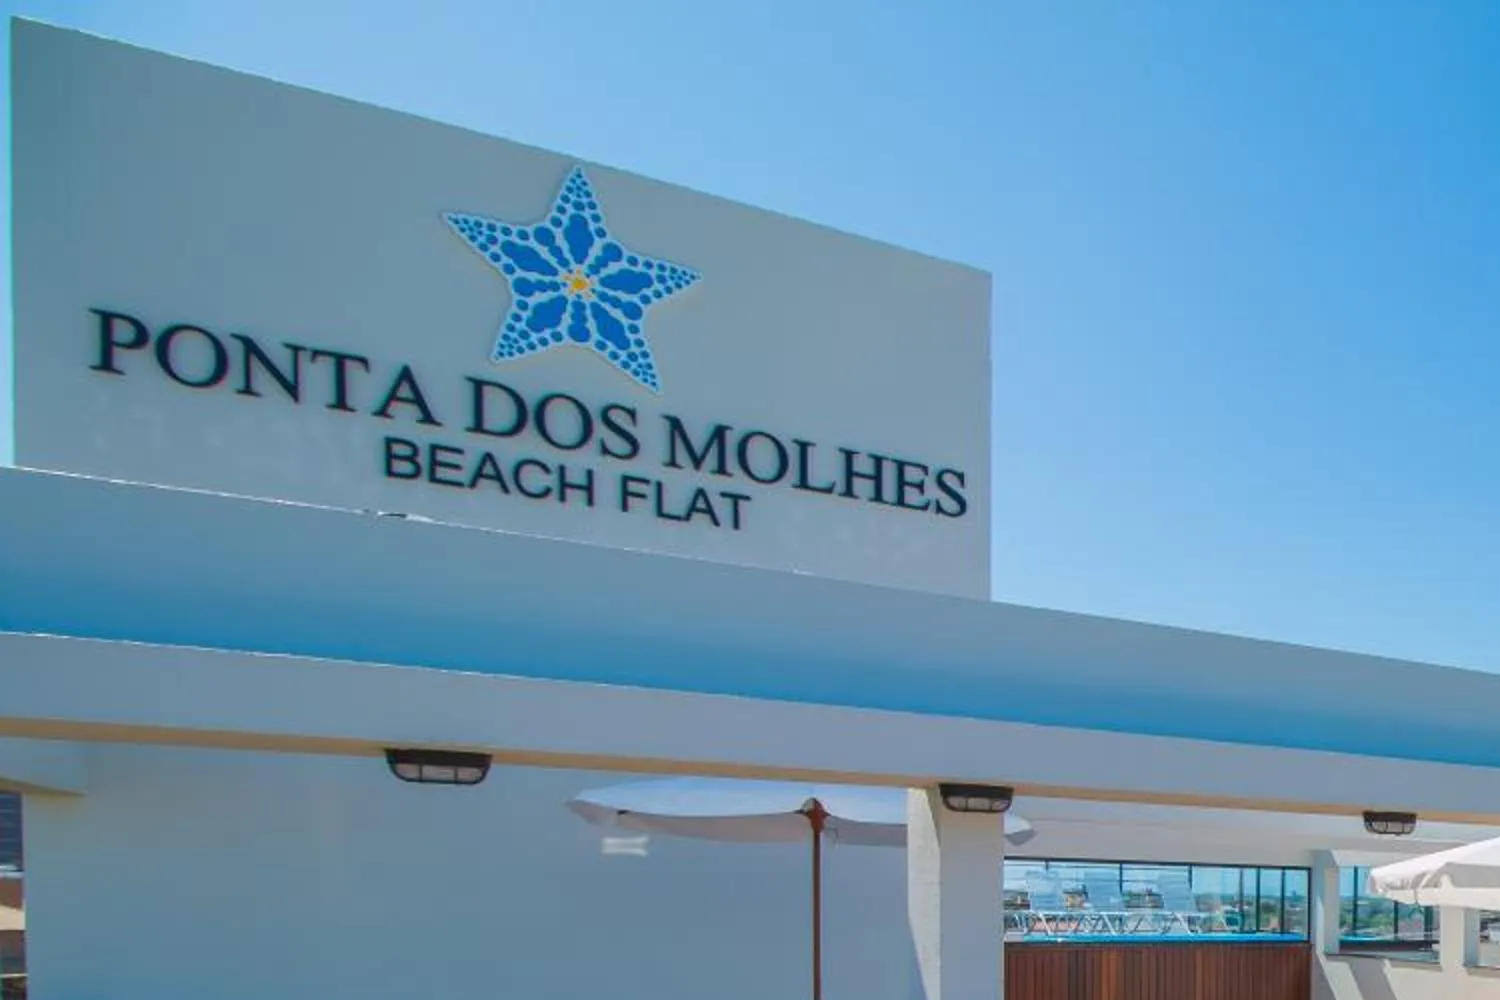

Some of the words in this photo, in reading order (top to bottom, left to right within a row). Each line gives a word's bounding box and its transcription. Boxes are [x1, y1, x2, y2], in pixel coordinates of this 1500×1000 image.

[88, 307, 443, 428] PONTA
[463, 375, 640, 460] DOS
[661, 413, 968, 518] MOLHES
[384, 436, 595, 507] BEACH
[620, 474, 752, 531] FLAT
